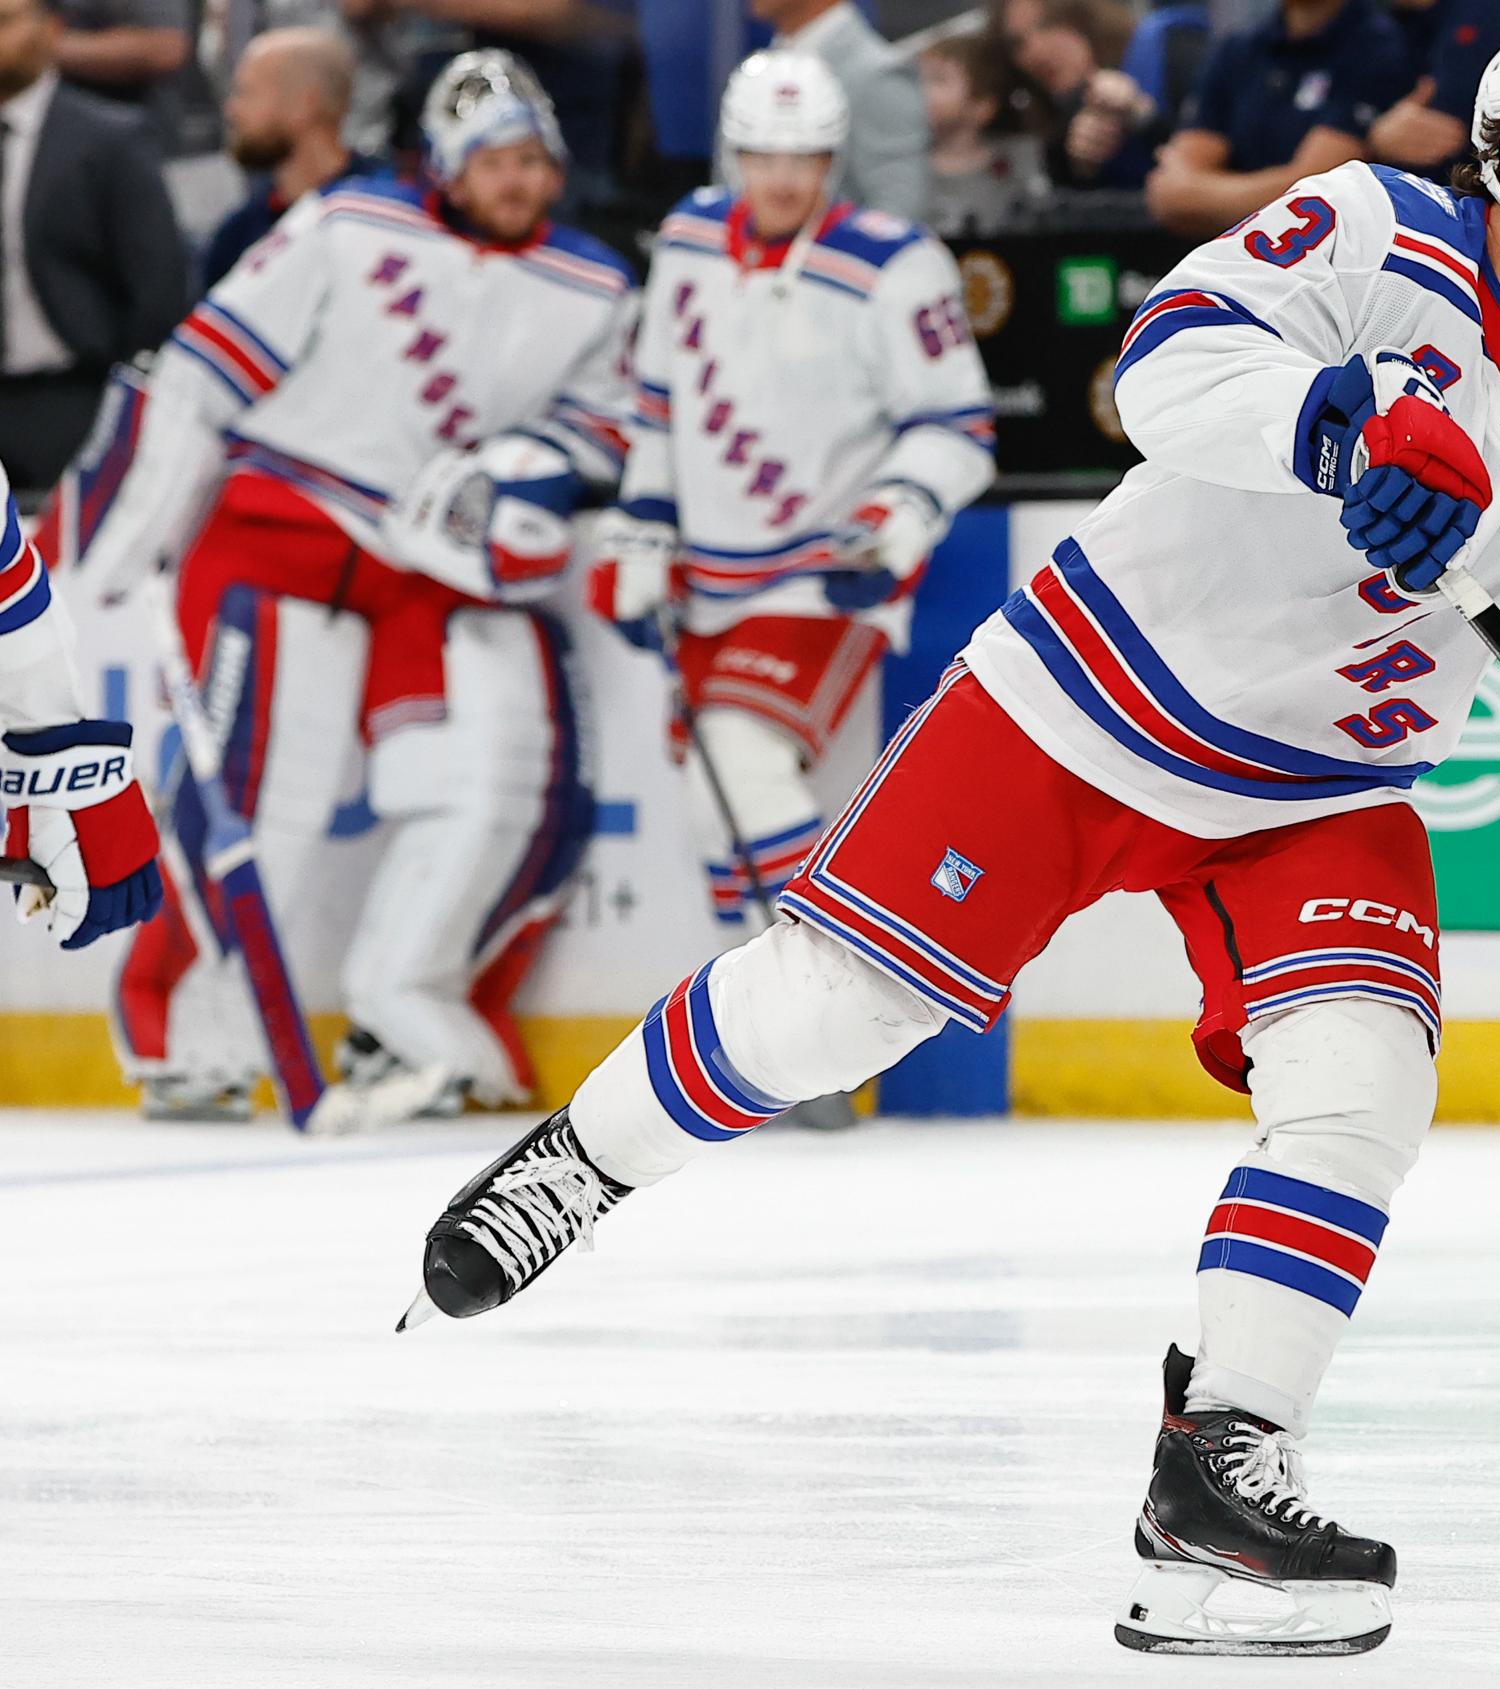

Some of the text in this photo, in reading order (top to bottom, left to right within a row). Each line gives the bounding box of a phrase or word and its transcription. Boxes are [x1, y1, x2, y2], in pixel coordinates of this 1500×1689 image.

[1214, 187, 1336, 269] 3
[1317, 434, 1332, 490] CCM
[1328, 456, 1338, 478] PRO
[0, 755, 126, 796] AUER
[1298, 898, 1435, 950] CCM
